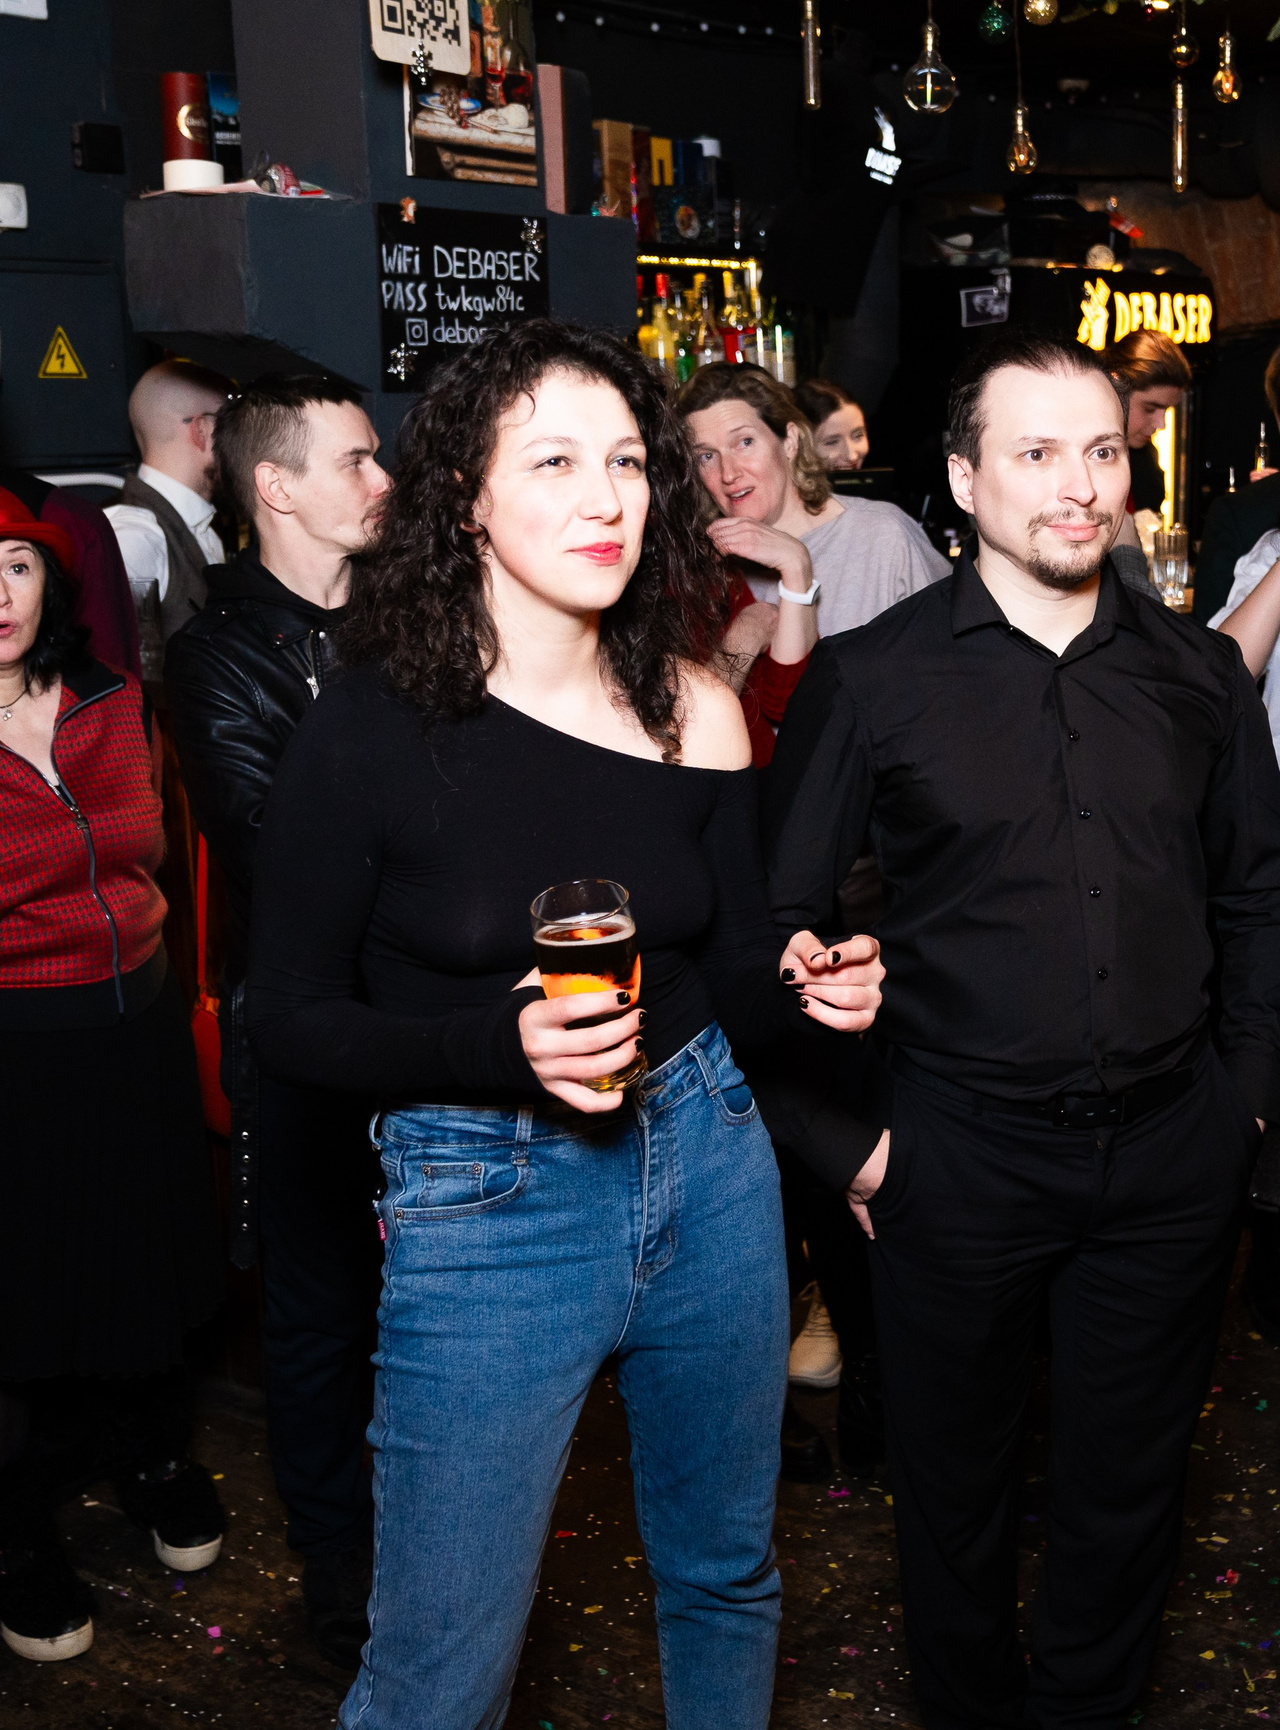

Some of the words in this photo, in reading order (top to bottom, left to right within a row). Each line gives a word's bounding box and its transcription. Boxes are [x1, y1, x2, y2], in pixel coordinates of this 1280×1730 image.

[382, 243, 420, 275] WiFi
[433, 245, 541, 282] DEBASER
[381, 281, 428, 312] PASS
